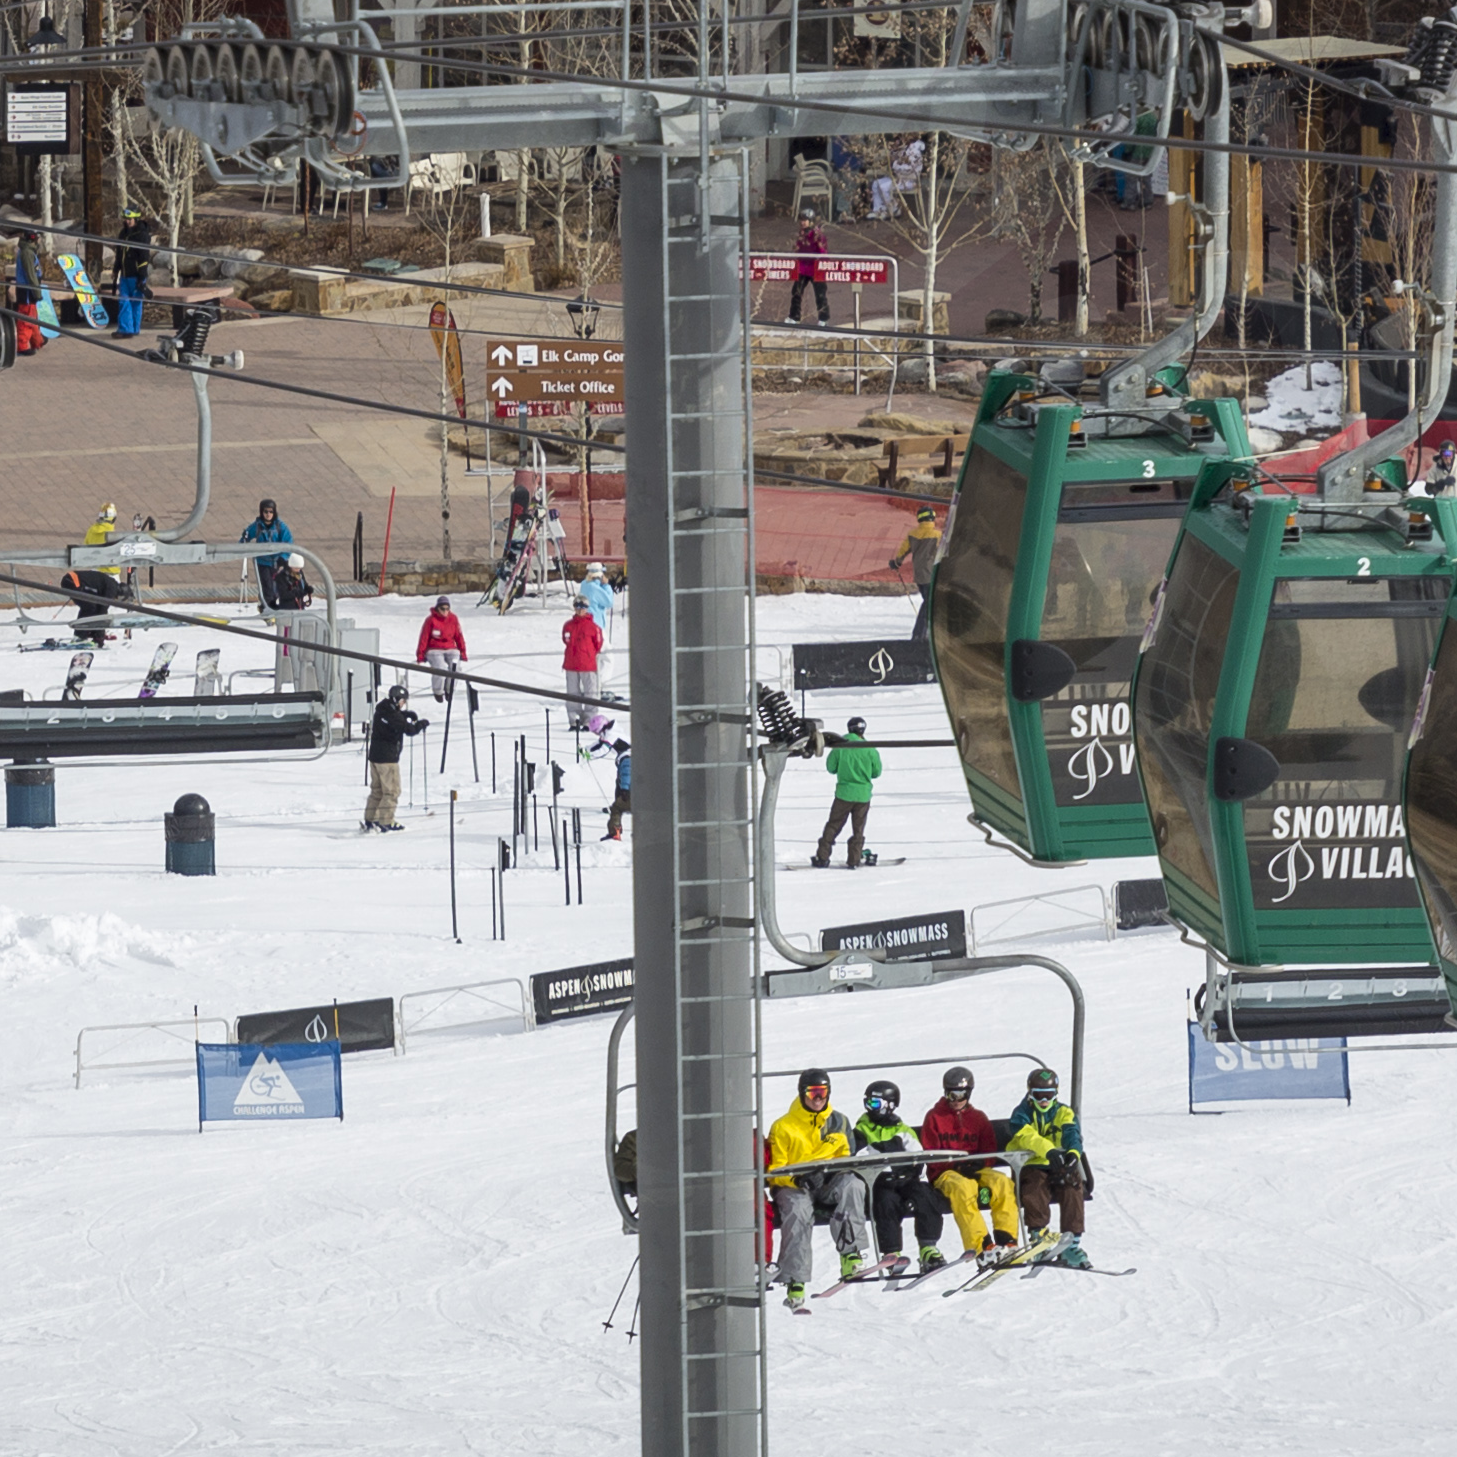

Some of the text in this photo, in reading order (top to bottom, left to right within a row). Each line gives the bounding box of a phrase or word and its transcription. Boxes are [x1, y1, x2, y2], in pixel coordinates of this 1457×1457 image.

[818, 260, 884, 271] ADULT SNOWBOARD
[825, 271, 850, 281] LEVELS
[542, 349, 559, 363] Elk
[563, 349, 599, 365] Camp
[540, 380, 615, 393] Ticket Office
[1143, 460, 1155, 478] 3
[1357, 556, 1371, 576] 2
[1070, 702, 1130, 738] SNO
[1119, 744, 1135, 775] V
[1272, 805, 1407, 840] SNOWMA
[840, 923, 948, 950] ASPEN SNOWMASS
[835, 966, 846, 979] 15
[548, 969, 634, 1000] ASPEN SNOWM
[1263, 978, 1407, 1003] 1 2 3
[1215, 1038, 1319, 1071] SLOW
[279, 1104, 304, 1114] ASPEN
